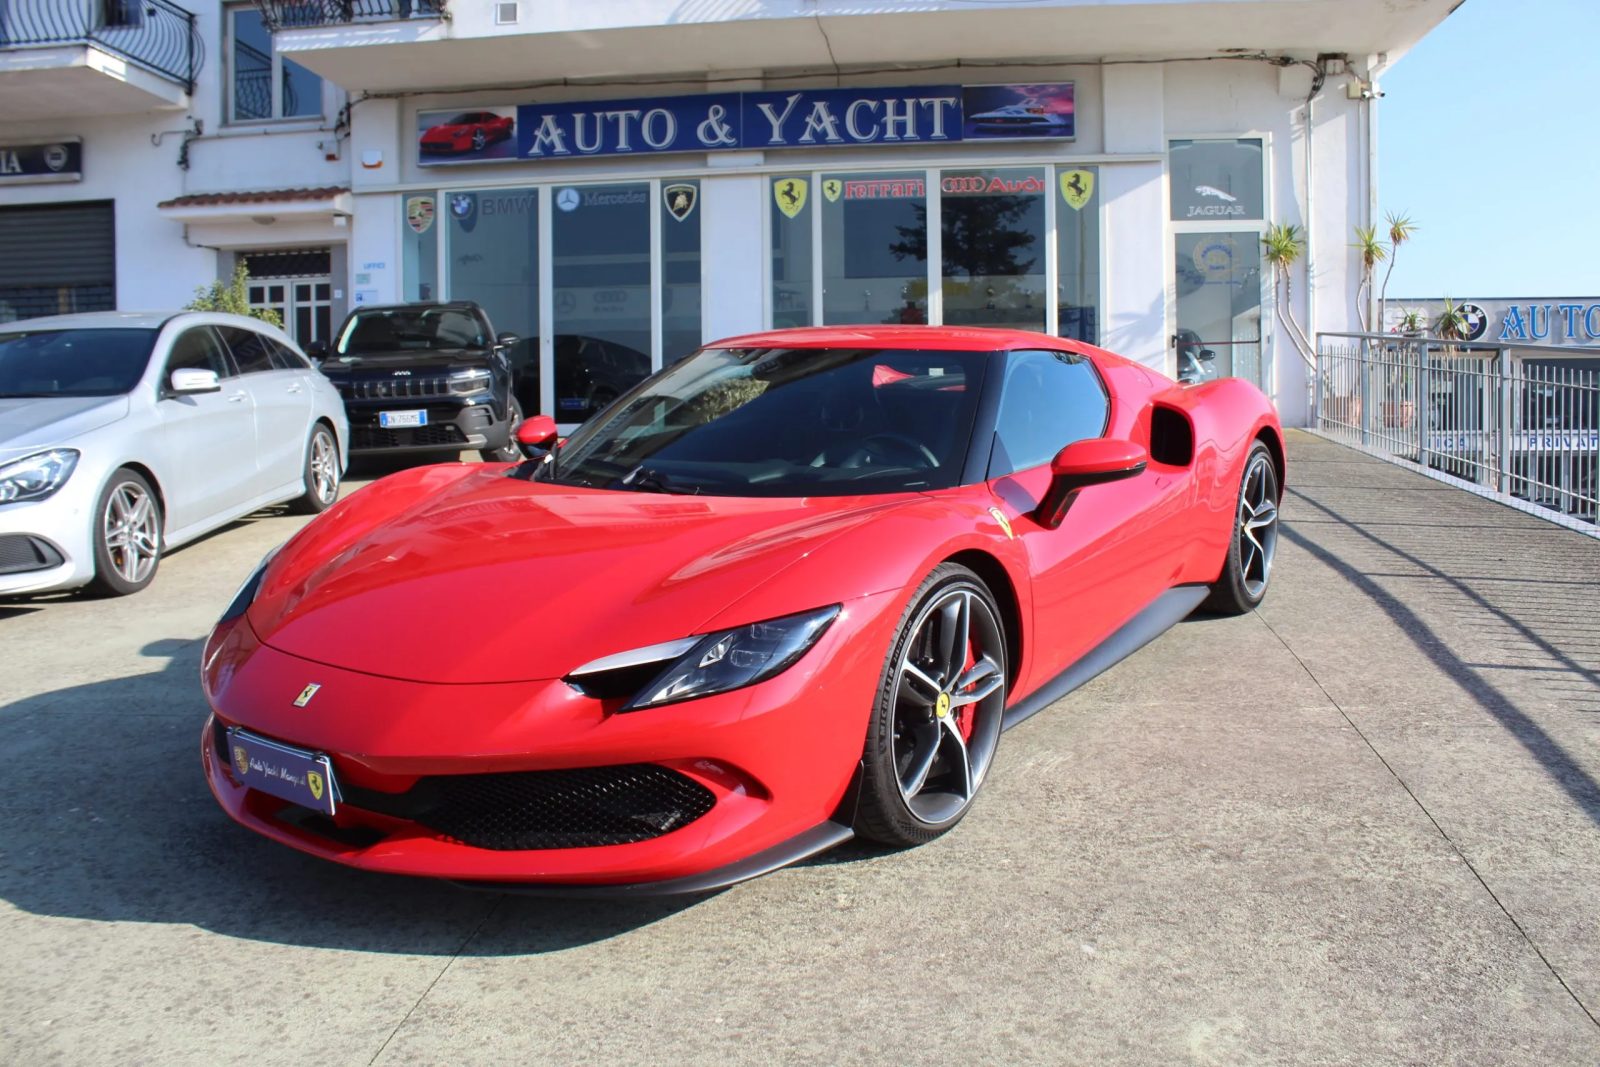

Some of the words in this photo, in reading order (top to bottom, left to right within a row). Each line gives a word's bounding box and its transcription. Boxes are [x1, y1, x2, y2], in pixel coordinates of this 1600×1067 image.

[528, 108, 677, 156] AUTO
[697, 104, 737, 146] &
[757, 93, 956, 145] YACHT
[844, 179, 925, 199] Ferrari
[984, 177, 1046, 193] Audi
[481, 194, 535, 216] BMW
[584, 190, 646, 206] Mercedes
[1187, 205, 1245, 217] JAGUAR
[880, 667, 894, 736] MICHELIN
